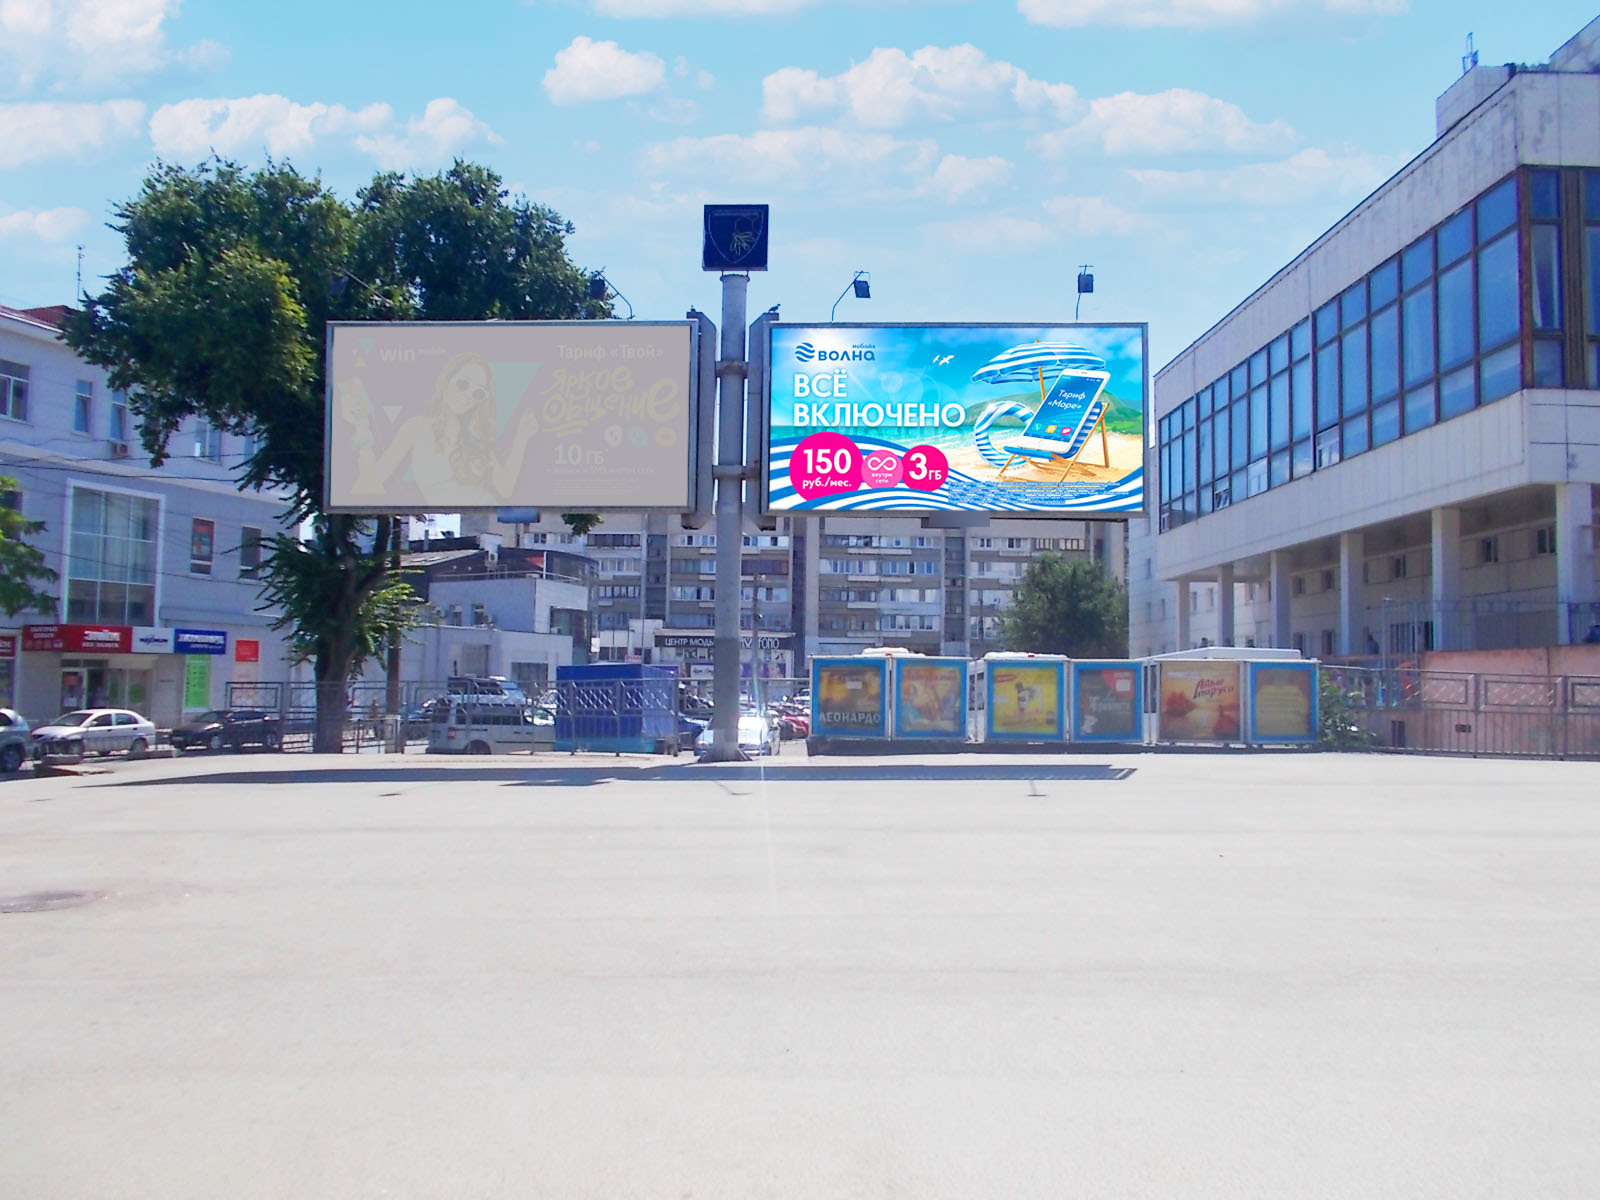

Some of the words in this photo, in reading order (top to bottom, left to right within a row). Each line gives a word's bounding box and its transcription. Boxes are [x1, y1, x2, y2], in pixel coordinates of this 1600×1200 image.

[555, 343, 606, 361] Тариф
[793, 368, 848, 398] ВСЁ
[1059, 389, 1086, 401] Тариф
[793, 402, 967, 428] ВКЛЮЧЕНО
[554, 442, 583, 465] 10
[803, 448, 852, 475] 150
[802, 477, 852, 490] руб./мес.
[664, 638, 689, 647] ЦЕНТР
[818, 711, 882, 725] ЛЕОНАРДО
